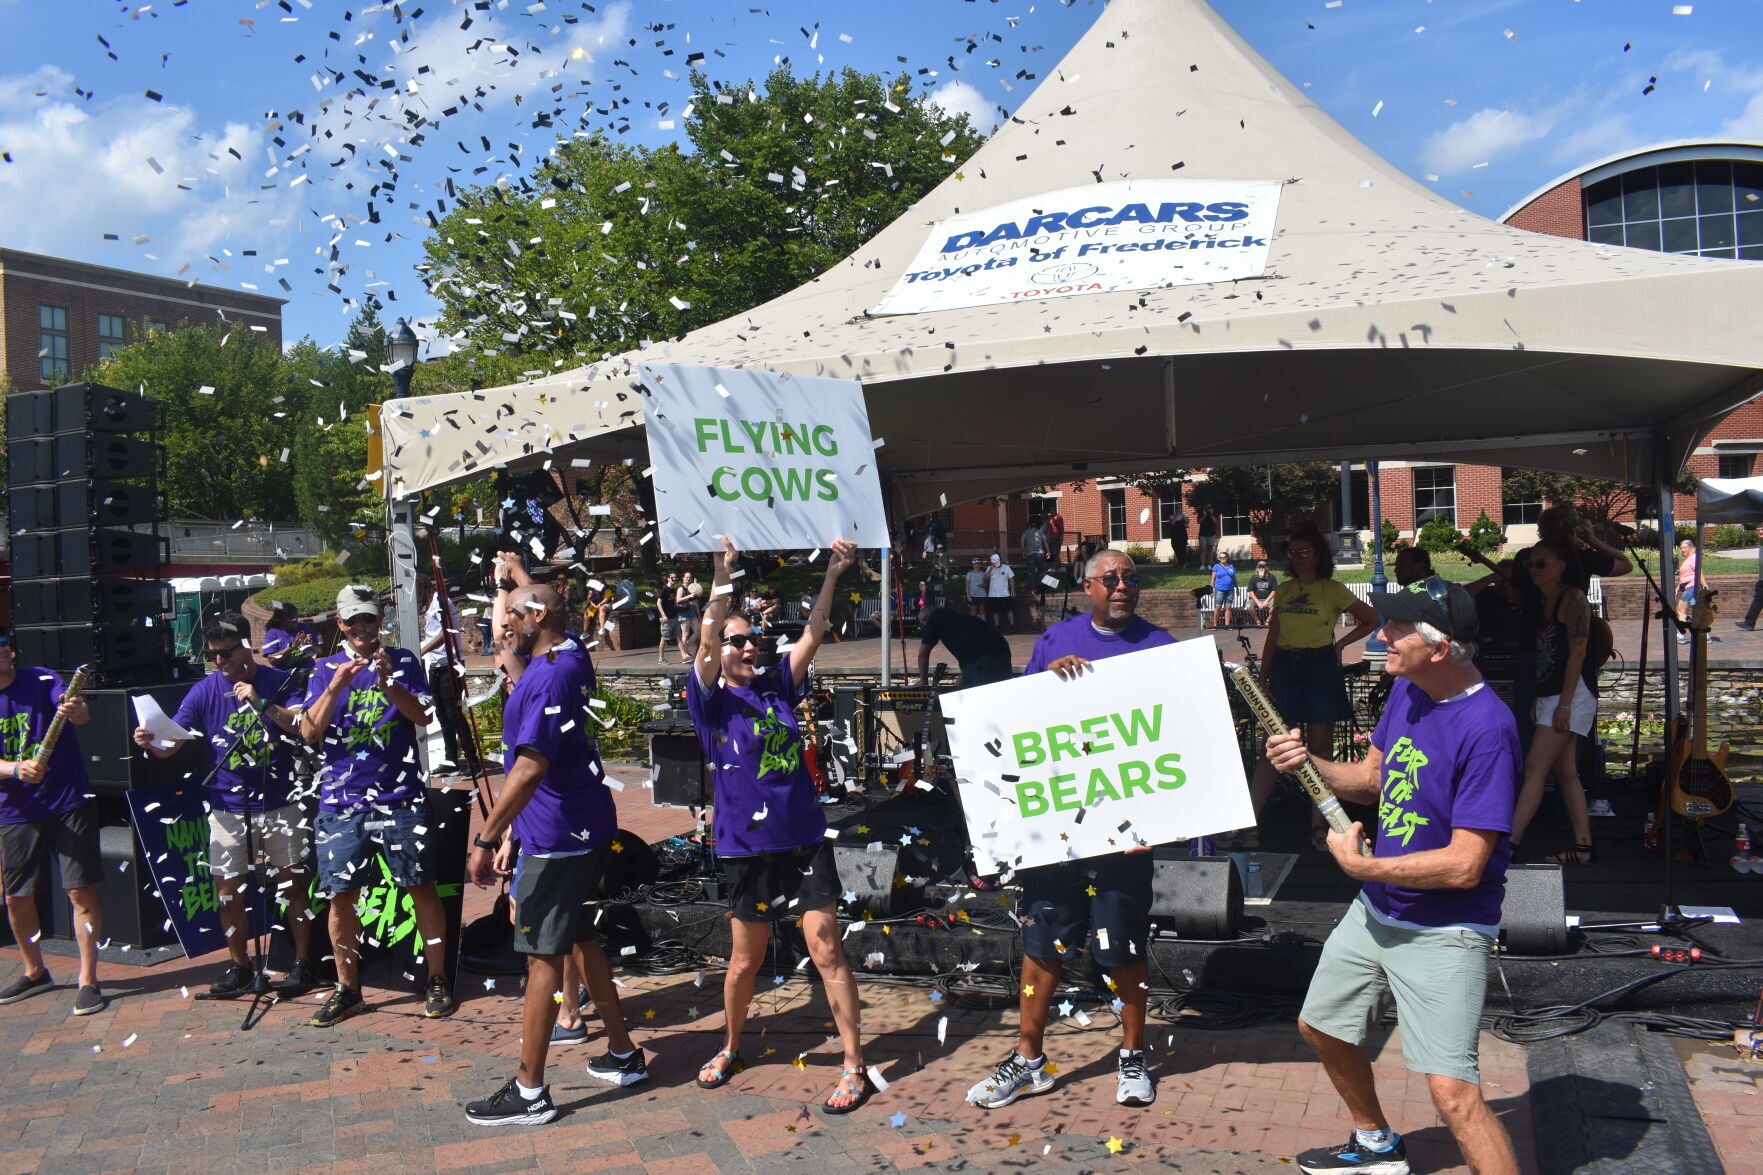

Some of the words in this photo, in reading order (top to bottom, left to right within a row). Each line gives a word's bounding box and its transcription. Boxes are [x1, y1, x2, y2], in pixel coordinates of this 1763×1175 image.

[938, 227, 1119, 261] AUTOMOTIVE
[1139, 222, 1248, 234] GROUP
[940, 202, 1249, 254] DARCARS
[906, 257, 1018, 284] Toyota
[1029, 247, 1068, 263] of
[1077, 236, 1267, 257] Frederick
[1011, 283, 1102, 299] TOYOTA
[694, 418, 839, 457] FLYING
[711, 466, 839, 501] COWS
[356, 705, 385, 727] THE
[1012, 704, 1163, 768] BREW
[1015, 753, 1187, 818] BEARS
[527, 1098, 547, 1113] HOKA
